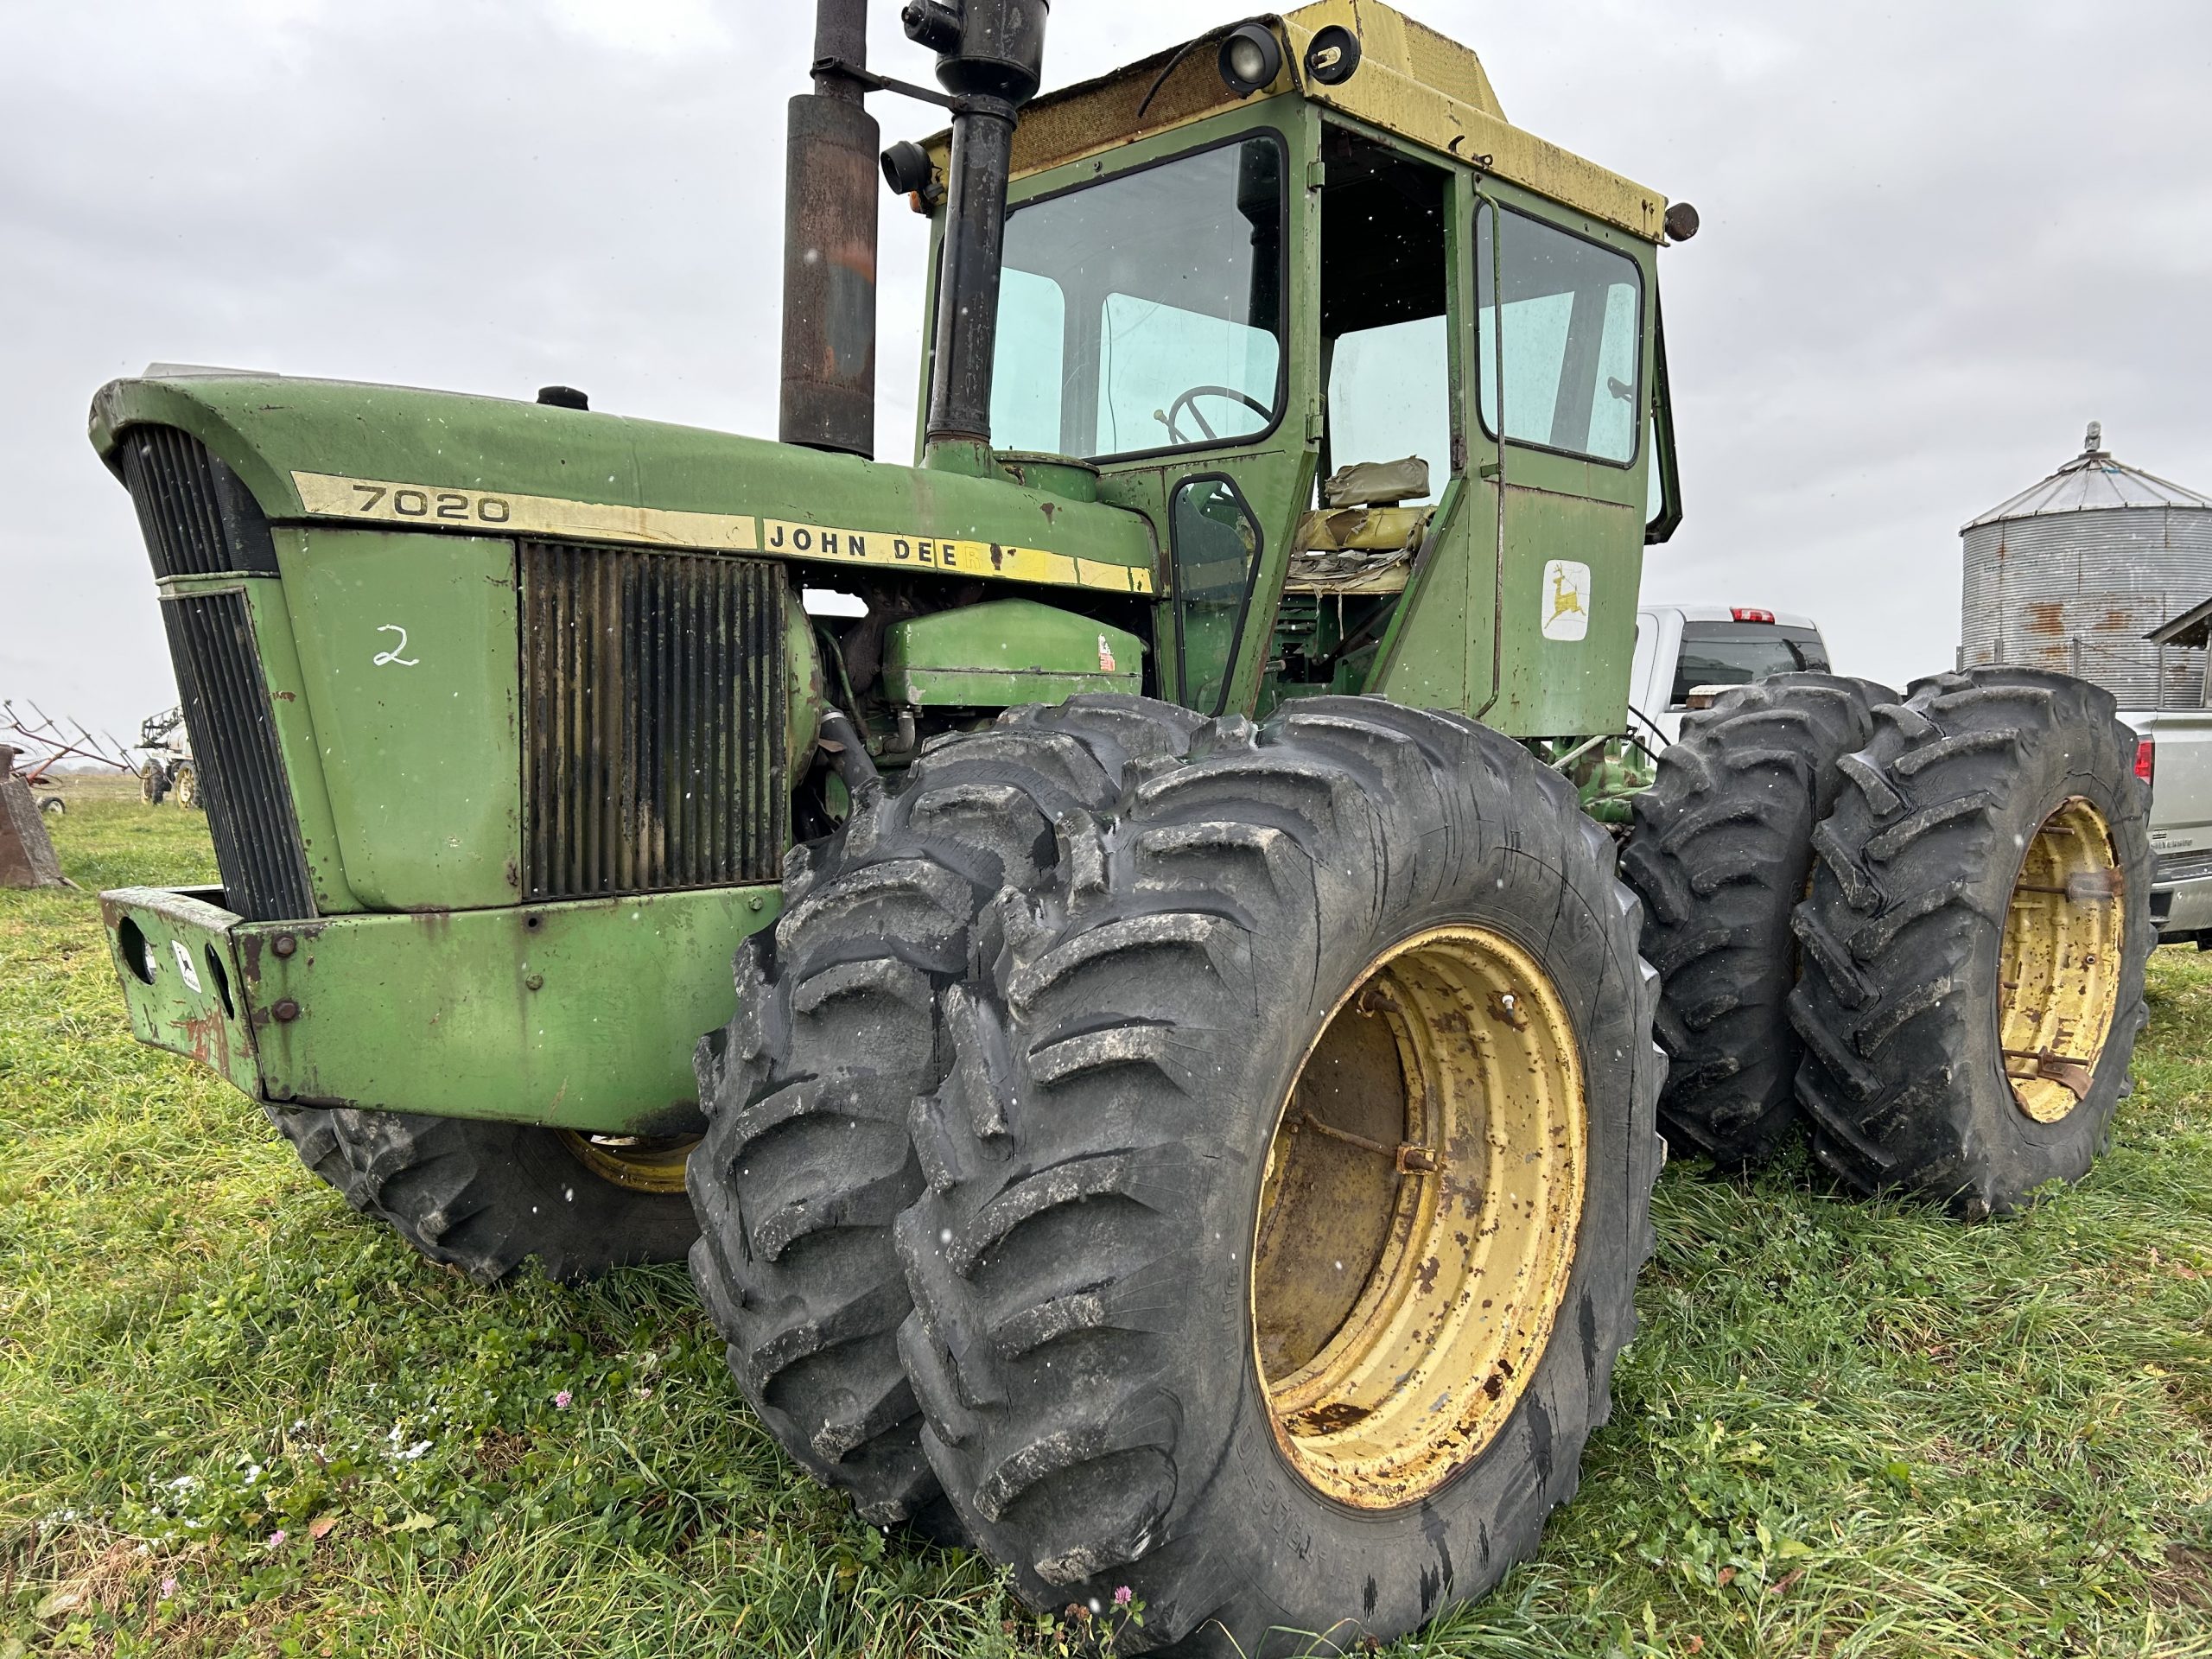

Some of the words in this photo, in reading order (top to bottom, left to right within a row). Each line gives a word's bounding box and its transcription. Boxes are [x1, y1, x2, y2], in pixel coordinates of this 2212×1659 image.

[353, 484, 510, 523] 7020
[770, 525, 866, 556] JOHN
[372, 623, 420, 666] 2
